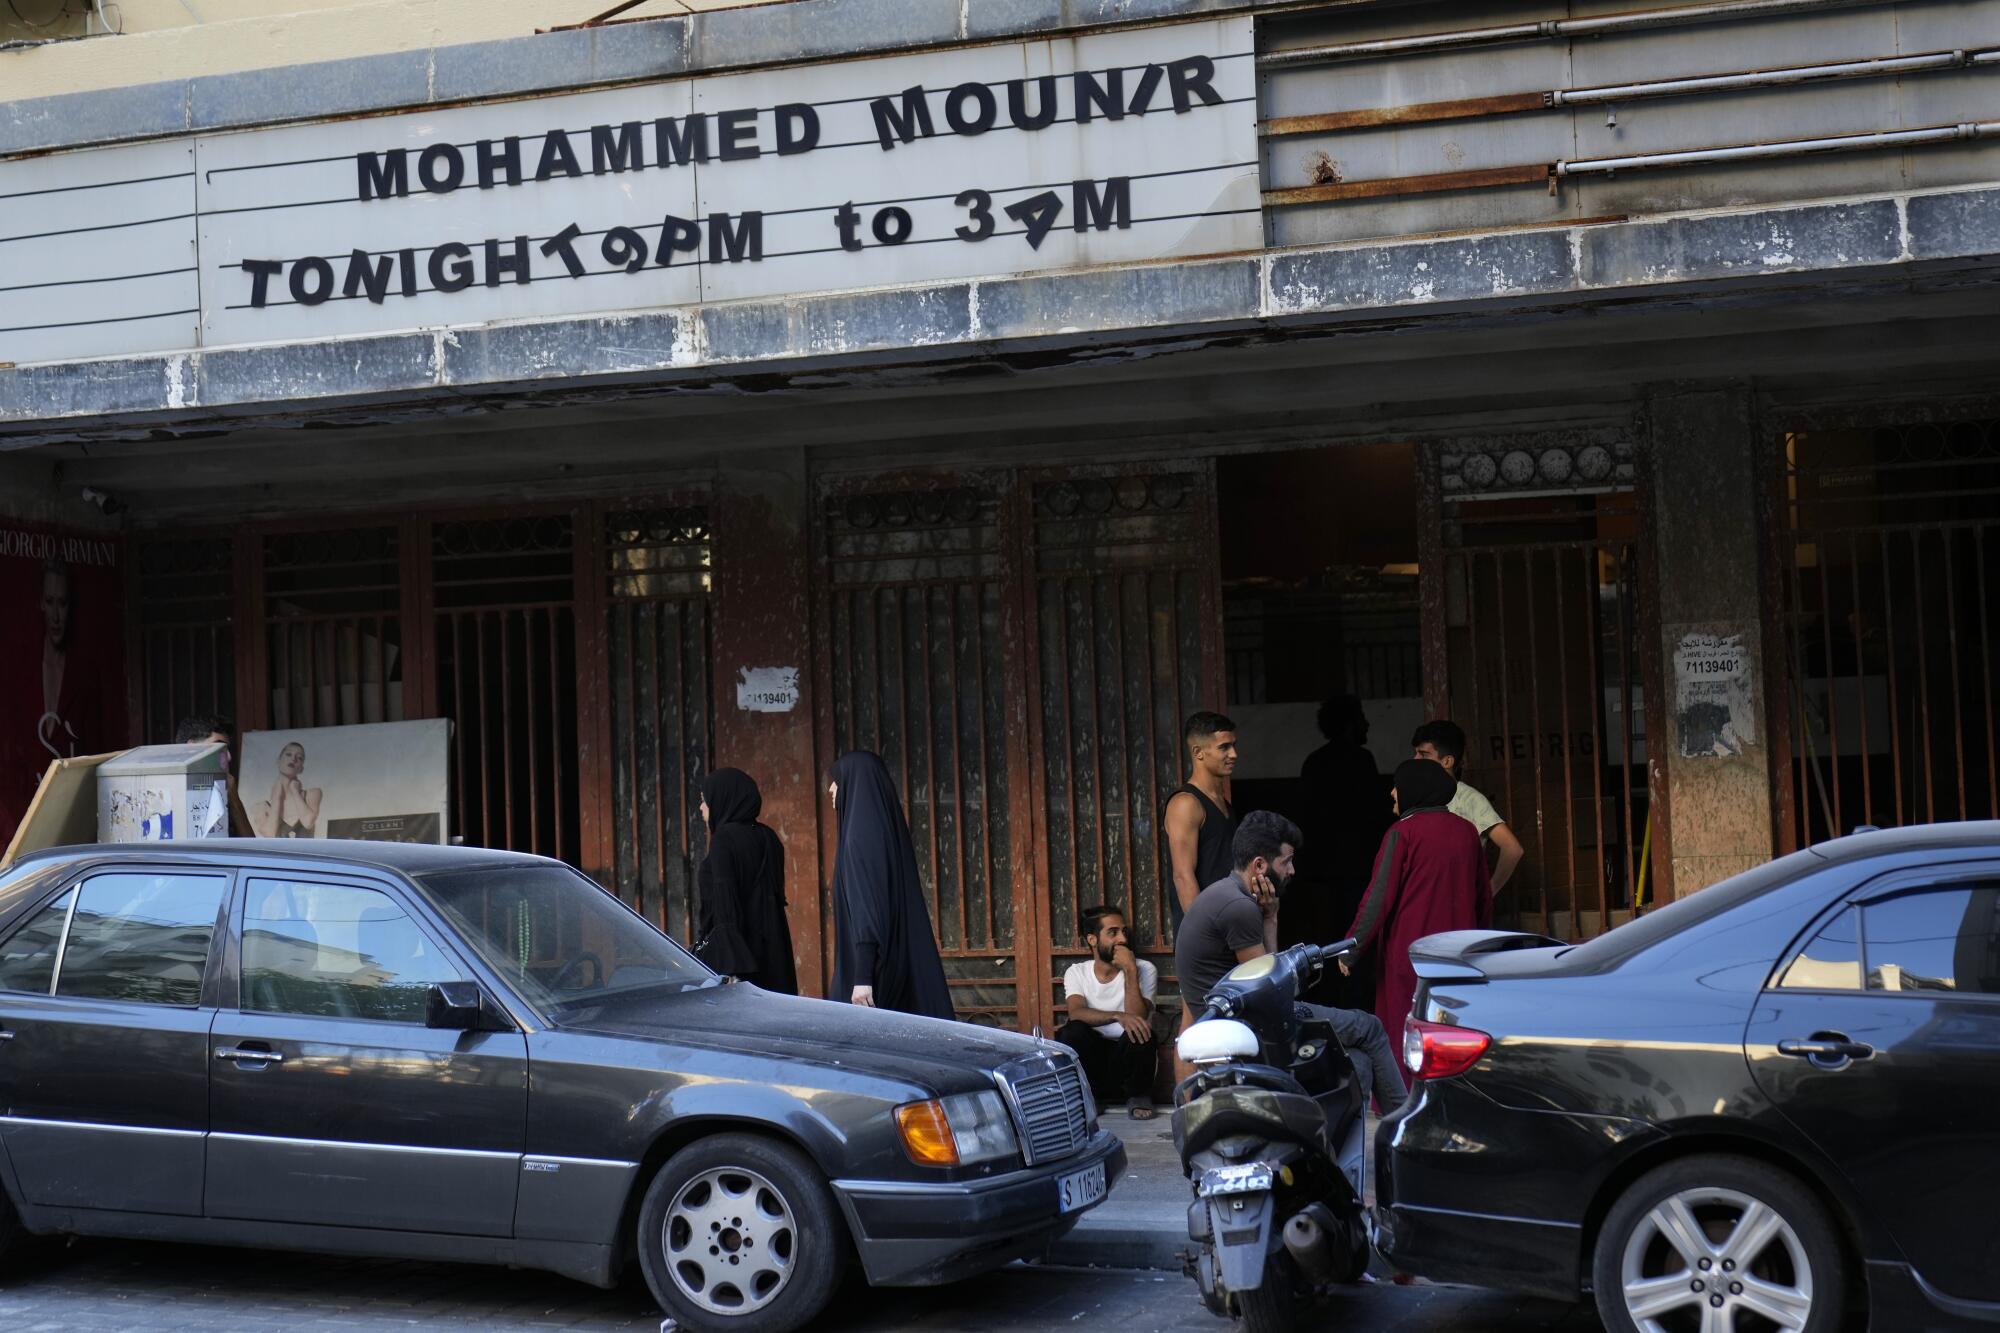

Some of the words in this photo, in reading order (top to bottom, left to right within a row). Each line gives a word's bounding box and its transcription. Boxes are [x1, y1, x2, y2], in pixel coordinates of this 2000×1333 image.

[357, 102, 821, 203] MOHAMMED
[872, 55, 1223, 150] MOUNIR
[834, 201, 913, 252] to
[61, 535, 115, 568] ARMANI
[1686, 659, 1739, 674] 71139401
[747, 692, 791, 704] 1139401
[1065, 1179, 1072, 1207] S
